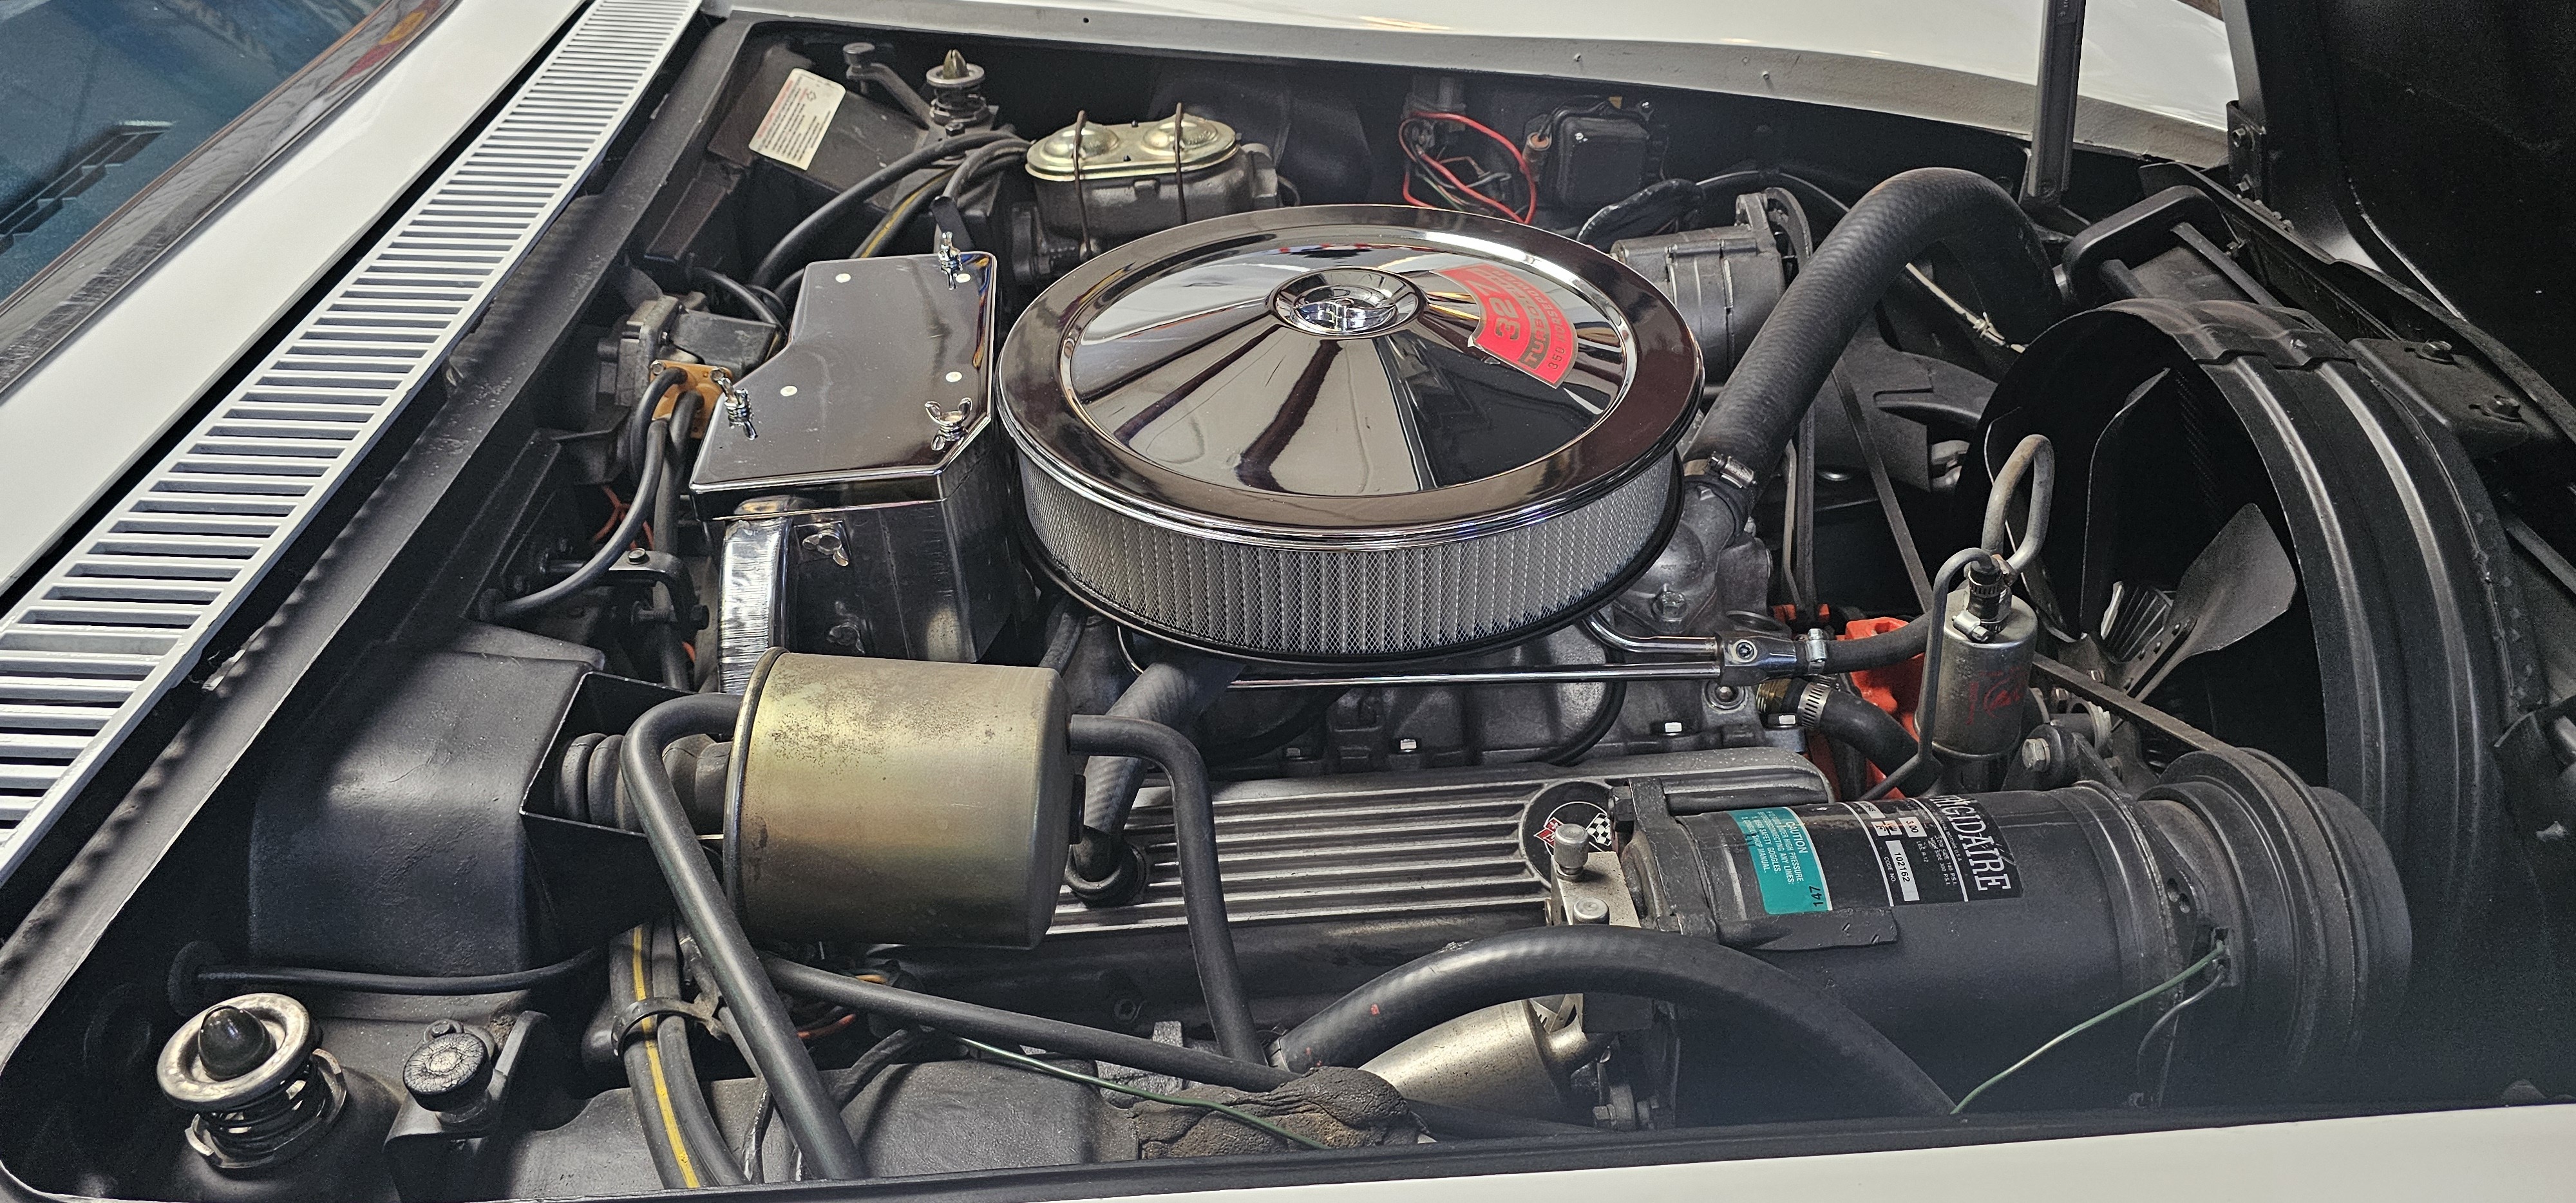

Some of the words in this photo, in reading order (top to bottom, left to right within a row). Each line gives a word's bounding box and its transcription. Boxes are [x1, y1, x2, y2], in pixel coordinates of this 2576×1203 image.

[1464, 279, 1520, 341] 327
[1548, 346, 1566, 370] 350
[1906, 820, 1919, 833] 3.00
[1752, 835, 1763, 848] SHOP
[1759, 829, 1773, 846] SAFETY
[1783, 838, 1794, 851] HIGH
[1785, 821, 1808, 854] CAUTION
[1779, 852, 1790, 864] ANY
[1884, 857, 1893, 871] CODE
[1894, 852, 1911, 882] 102162
[1808, 886, 1824, 907] 147
